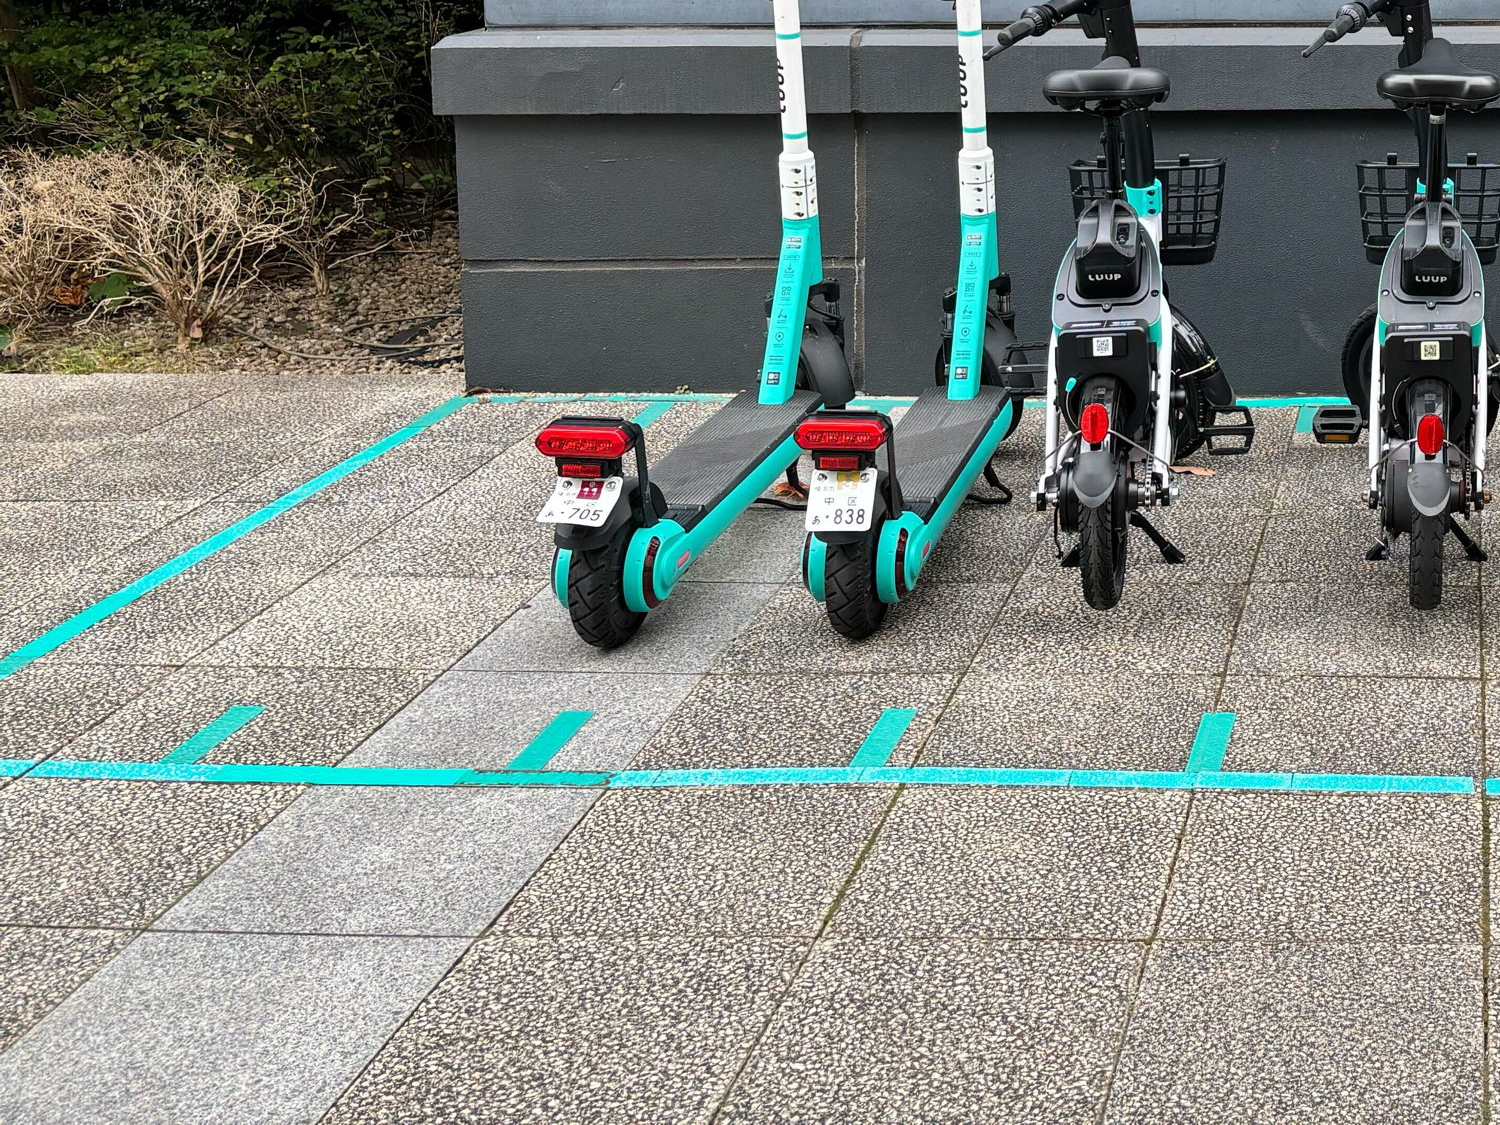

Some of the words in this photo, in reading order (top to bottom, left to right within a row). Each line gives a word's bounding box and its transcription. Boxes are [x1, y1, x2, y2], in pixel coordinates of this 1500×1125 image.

[958, 54, 969, 109] LUUP
[1088, 273, 1122, 282] LUUP
[1415, 275, 1448, 283] LUUP
